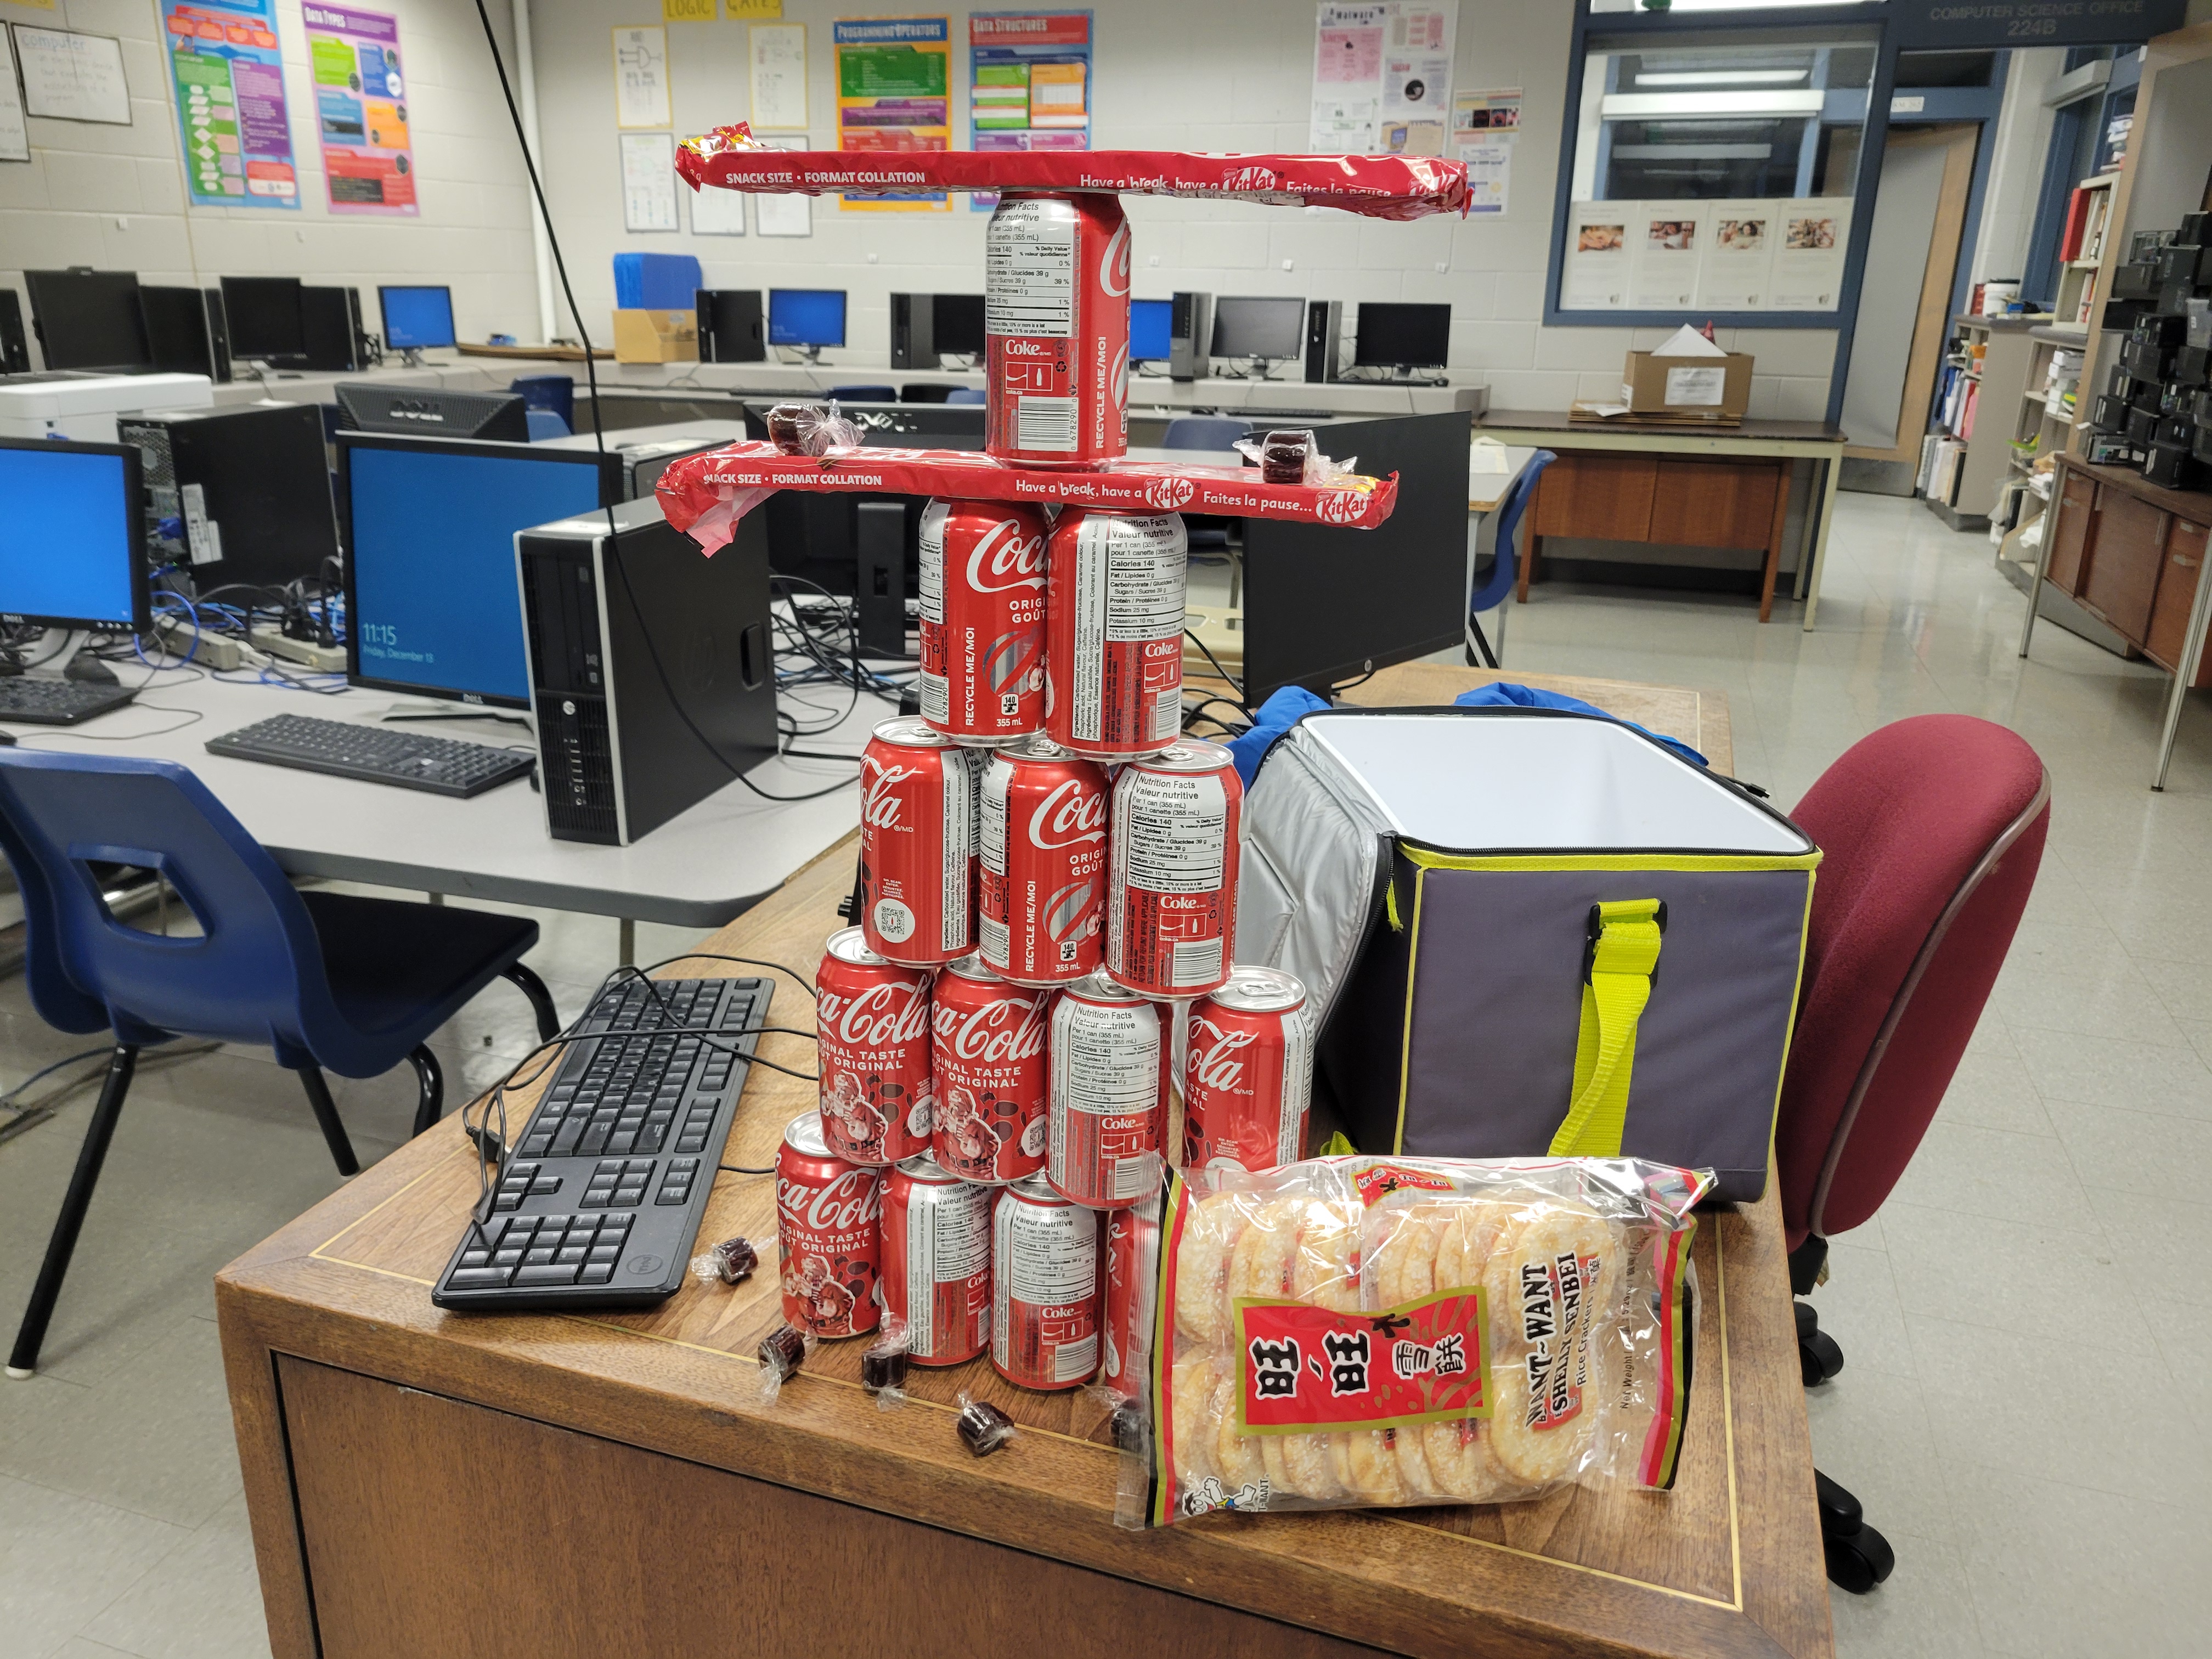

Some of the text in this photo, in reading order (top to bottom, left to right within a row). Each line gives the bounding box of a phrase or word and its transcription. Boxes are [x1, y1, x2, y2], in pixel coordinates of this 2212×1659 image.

[1930, 0, 2143, 20] COMPUTER SCIENCE OFFICE
[2007, 18, 2057, 37] 224B
[21, 33, 87, 52] computer
[726, 171, 926, 184] SNACK SIZE FORMAT COLLATION
[1080, 174, 1113, 188] Have
[1116, 179, 1125, 188] a
[1175, 176, 1206, 189] have
[1286, 181, 1327, 193] Faites
[1331, 183, 1344, 194] la
[1017, 202, 1039, 211] Facts
[1006, 213, 1040, 222] nutritive
[1005, 338, 1041, 356] Coke
[1096, 336, 1107, 449] RECYCLE ME/MOI
[703, 473, 882, 486] SNACK SIZE FORMAT COLLATION
[1015, 479, 1046, 493] Have
[1048, 484, 1056, 493] a
[1101, 486, 1131, 498] have
[1134, 490, 1142, 499] a
[1145, 478, 1194, 509] KitKat
[1203, 492, 1241, 506] Faites
[1244, 494, 1256, 506] la
[1316, 491, 1368, 523] KitKat
[1150, 518, 1169, 528] Facts
[1112, 529, 1174, 539] Valeur nutritive
[1143, 559, 1155, 567] 140
[1009, 597, 1046, 611] ORIGI
[1012, 609, 1047, 623] GOÛT
[362, 622, 397, 646] 11:15
[387, 648, 424, 662] December
[1145, 642, 1173, 658] Coke
[965, 627, 976, 726] RECYCLE ME/MOI
[1005, 696, 1016, 704] 140
[996, 717, 1023, 727] 355 mL
[1138, 775, 1195, 789] Nutrition Facts
[1135, 786, 1199, 800] Valeur nutritive
[1132, 795, 1142, 804] Per
[1159, 800, 1173, 809] (355
[1174, 802, 1187, 810] mL)
[1131, 804, 1143, 812] pour
[1149, 807, 1171, 816] canette
[1172, 809, 1187, 817] (355
[1131, 812, 1158, 824] Calories
[1130, 832, 1165, 844] Carbohydrate
[1133, 839, 1151, 848] Sugars
[1130, 847, 1148, 856] Protein
[1129, 855, 1148, 864] Sodium
[1071, 859, 1104, 876] GOÛT
[1129, 865, 1154, 876] Potassium
[1160, 895, 1197, 910] Coke
[1025, 881, 1036, 972] RECYCLE ME/MOI
[1055, 962, 1081, 972] 355 mL
[816, 973, 932, 1046] ca-Cola
[1076, 1007, 1133, 1020] Nutrition Facts
[932, 990, 1049, 1063] ca-Cola
[1072, 1026, 1082, 1035] Per
[821, 1040, 906, 1062] GINAL TASTE
[1071, 1042, 1097, 1053] Calories
[833, 1057, 904, 1072] ORIGINAL
[973, 1065, 1022, 1078] TASTE
[948, 1073, 1019, 1089] ORIGINAL
[1102, 1117, 1137, 1130] Coke
[937, 1186, 967, 1196] Nutrition
[937, 1186, 988, 1206] Valeur nutritive
[1018, 1205, 1048, 1217] Nutrition
[1015, 1214, 1038, 1227] Valeur
[780, 1219, 871, 1244] RIGINAL TASTE
[801, 1241, 869, 1254] ORIGINAL
[1013, 1238, 1037, 1249] Calories
[1042, 1307, 1075, 1318] Coke
[1552, 1252, 1580, 1413] SHELLY SENBEI
[1577, 1295, 1593, 1386] Rice Crackers
